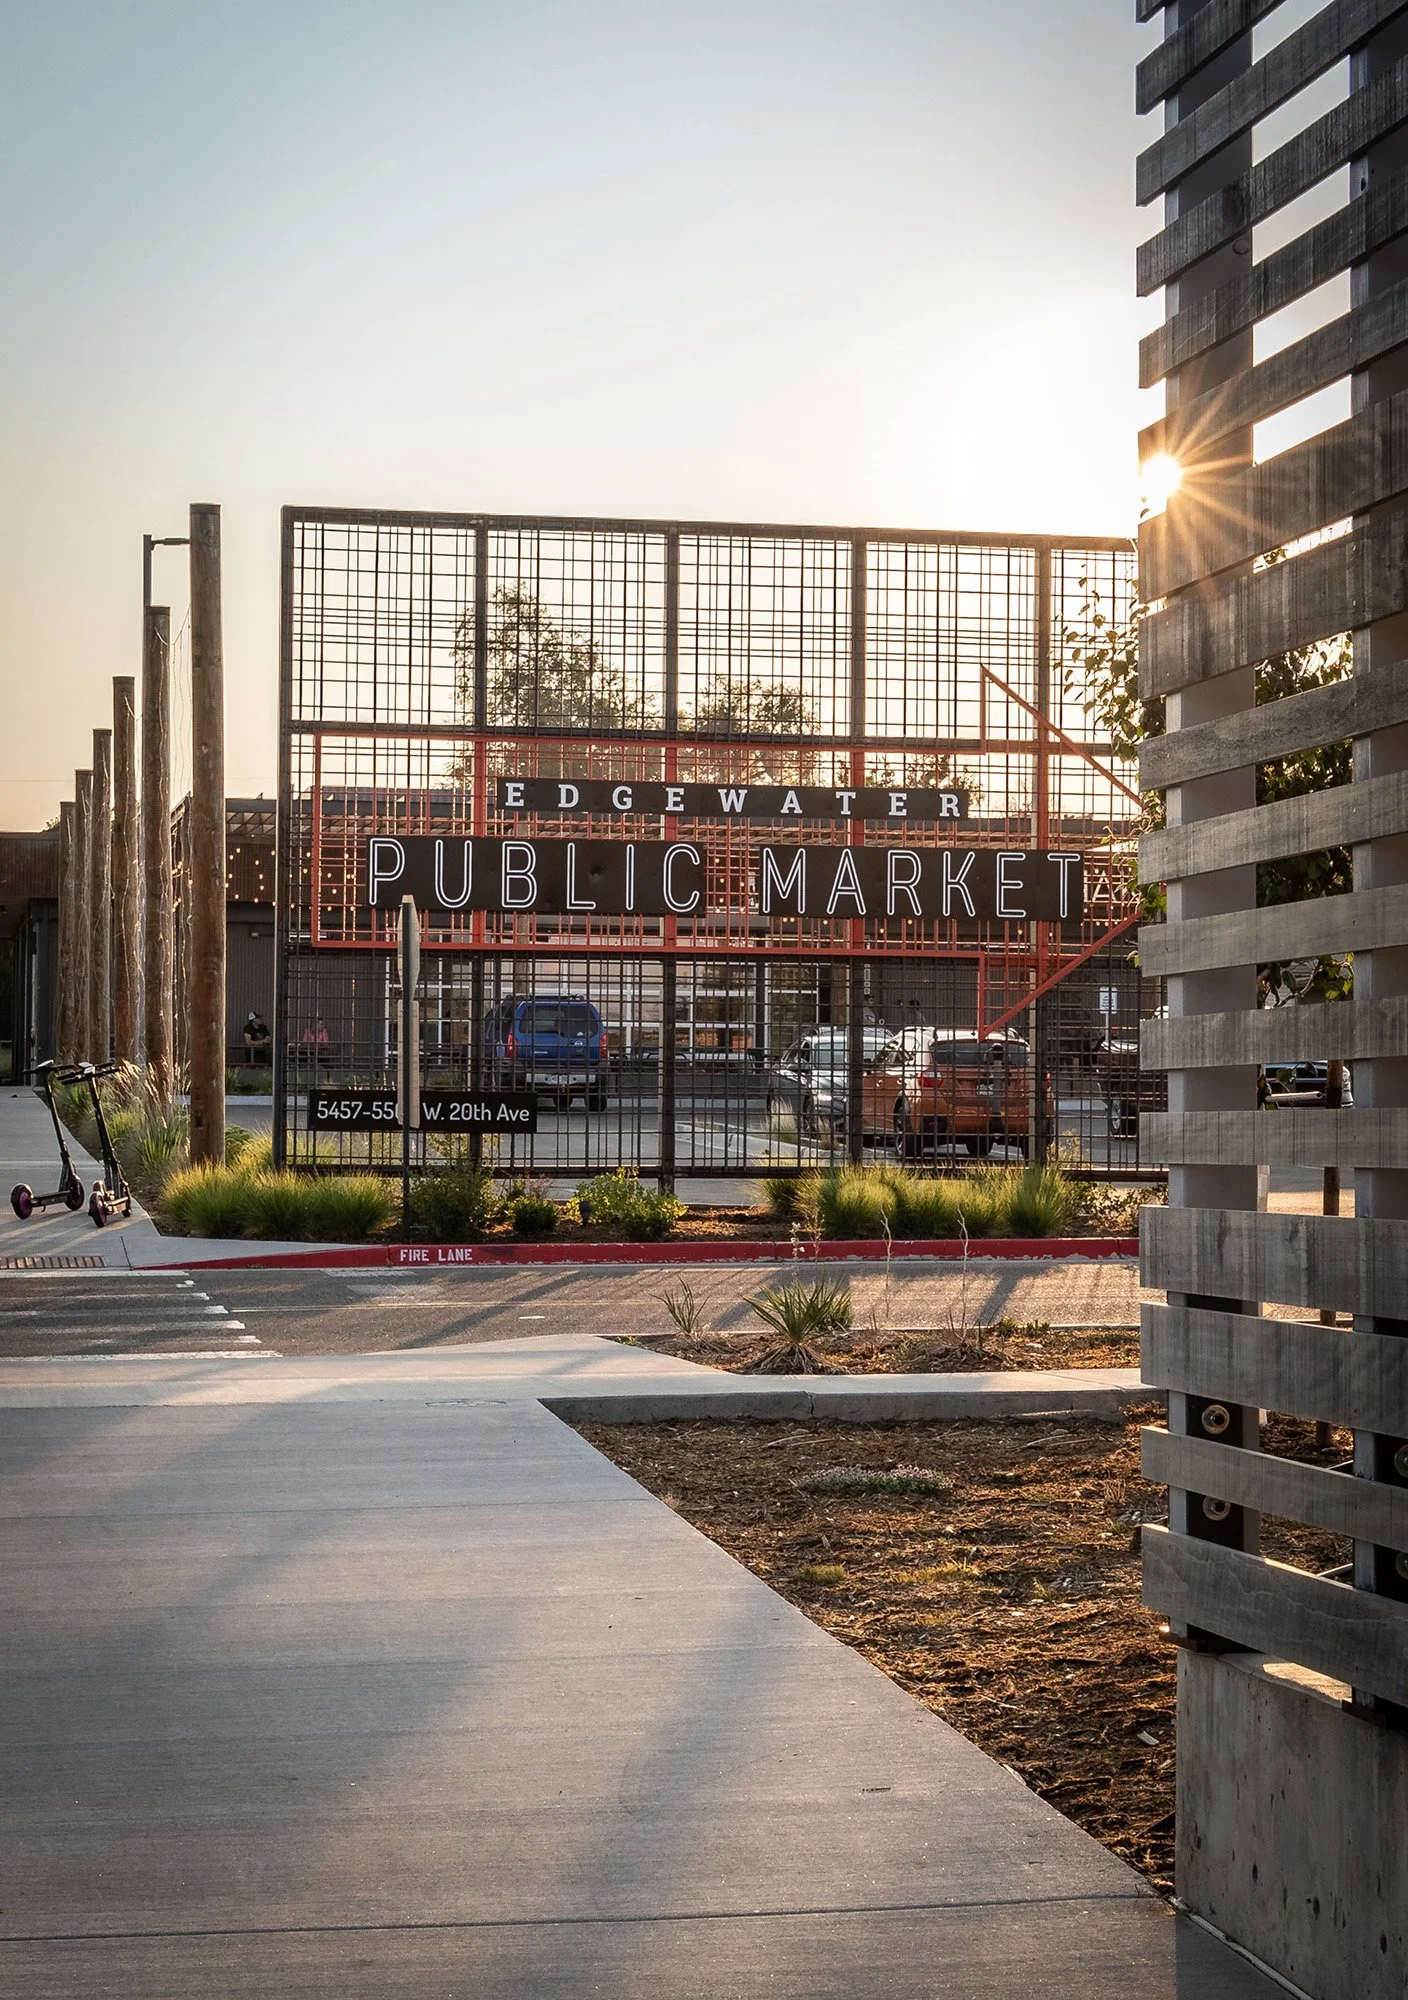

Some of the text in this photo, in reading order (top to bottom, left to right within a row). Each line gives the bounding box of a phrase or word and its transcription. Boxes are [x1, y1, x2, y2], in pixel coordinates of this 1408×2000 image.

[505, 782, 960, 818] EDGEWATER
[368, 837, 701, 913] PUBLIC
[762, 847, 1081, 919] MARKET
[422, 1102, 445, 1120] W.
[449, 1102, 492, 1121] 20th
[496, 1103, 530, 1121] Ave
[400, 1248, 473, 1261] FIRE LANE
